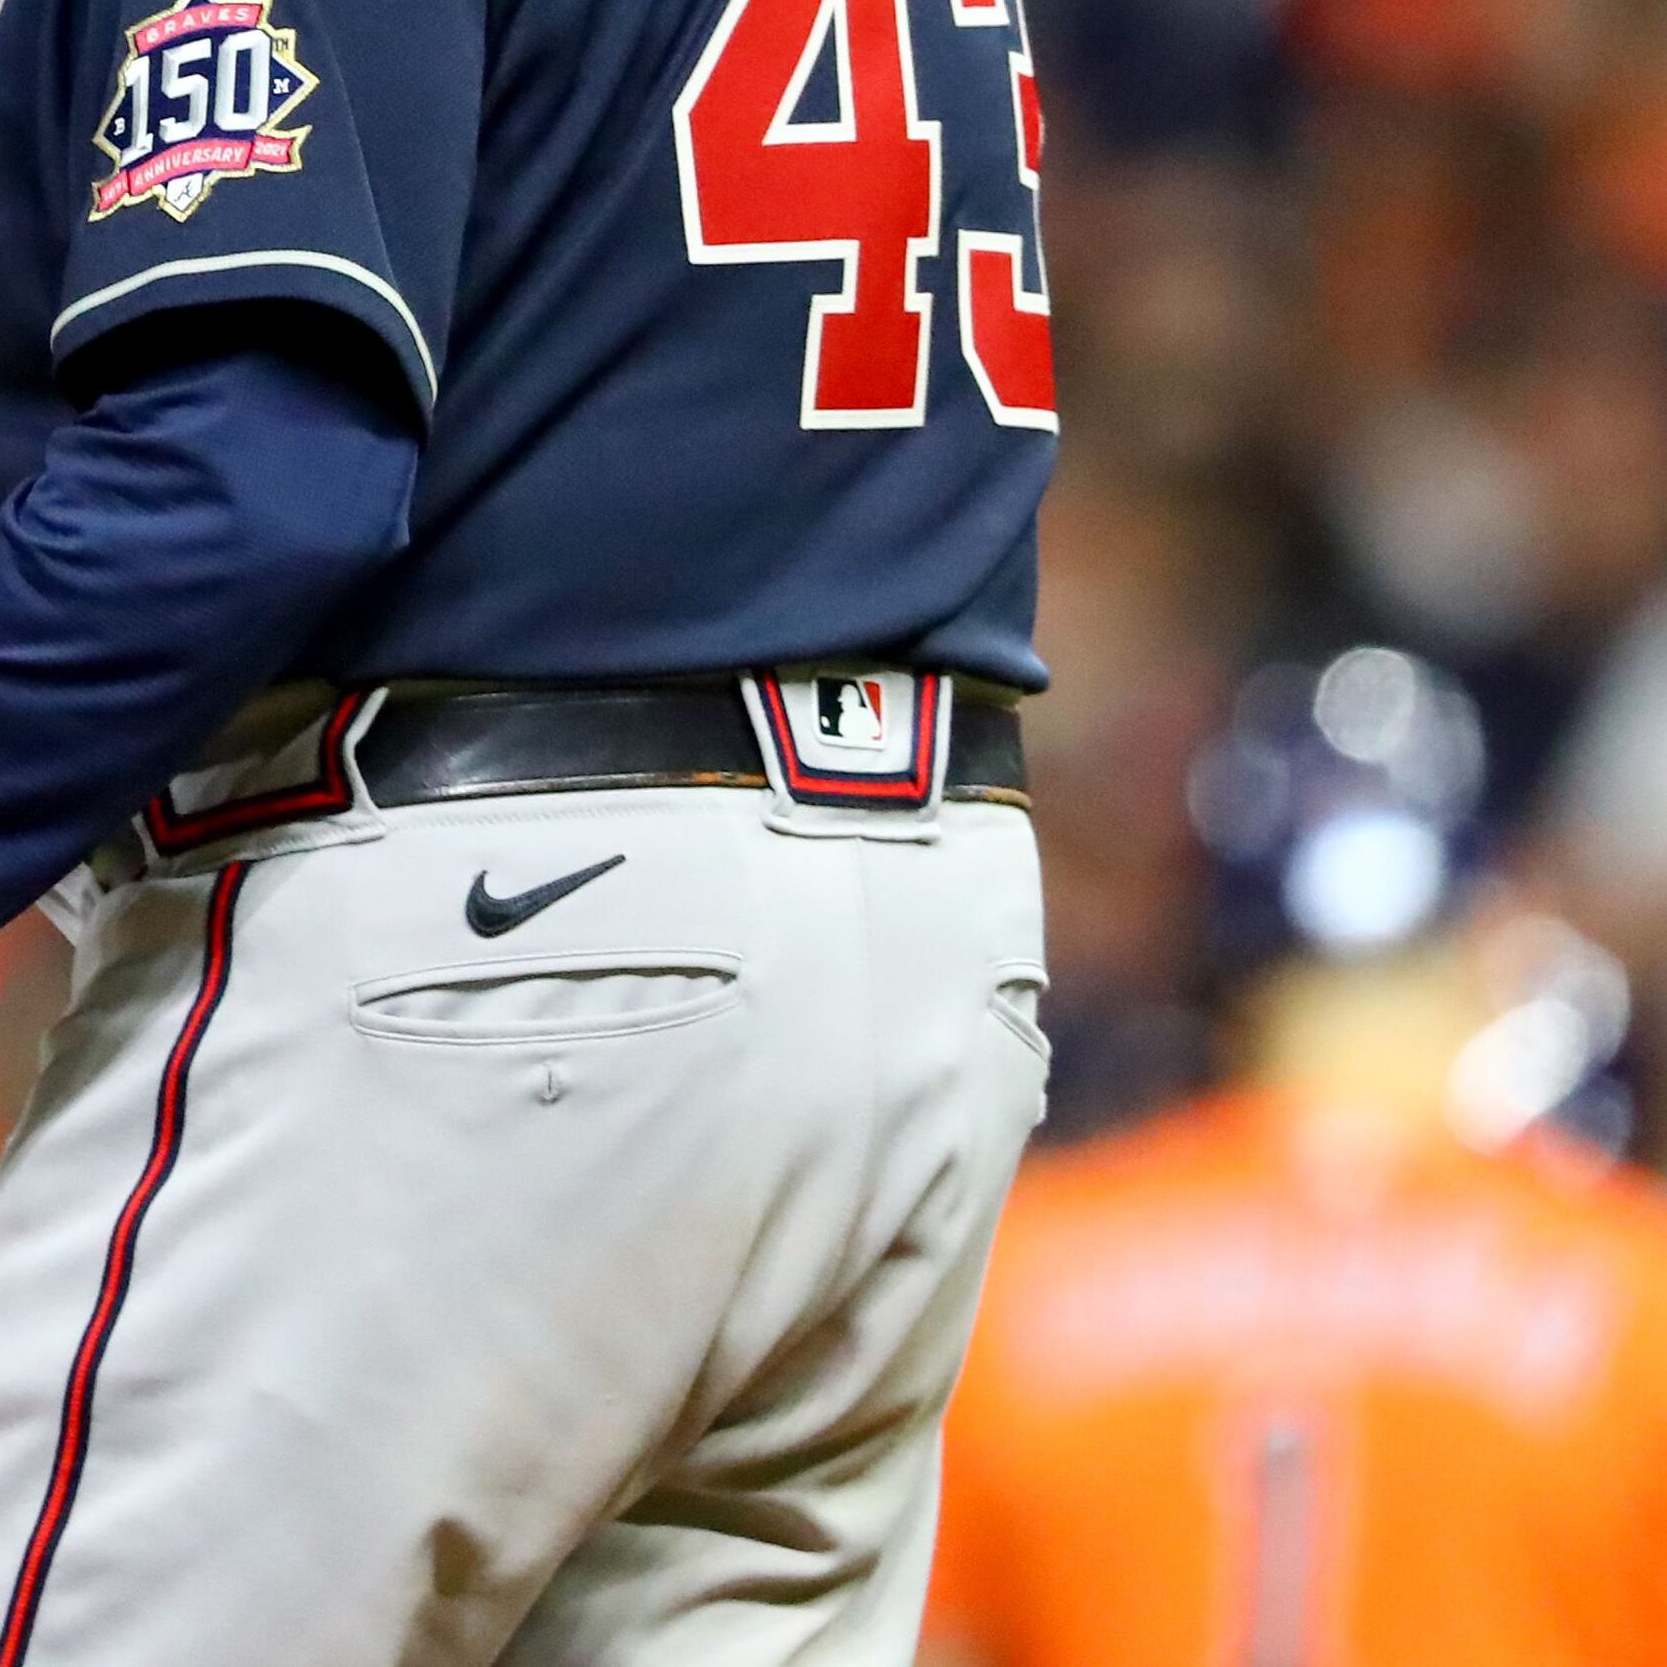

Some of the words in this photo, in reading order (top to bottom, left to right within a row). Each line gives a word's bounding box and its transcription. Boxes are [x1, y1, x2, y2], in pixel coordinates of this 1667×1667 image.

[146, 6, 250, 44] BRAVES
[120, 29, 271, 168] 150
[134, 146, 245, 188] ANNIVERSARY
[254, 141, 288, 158] 2021
